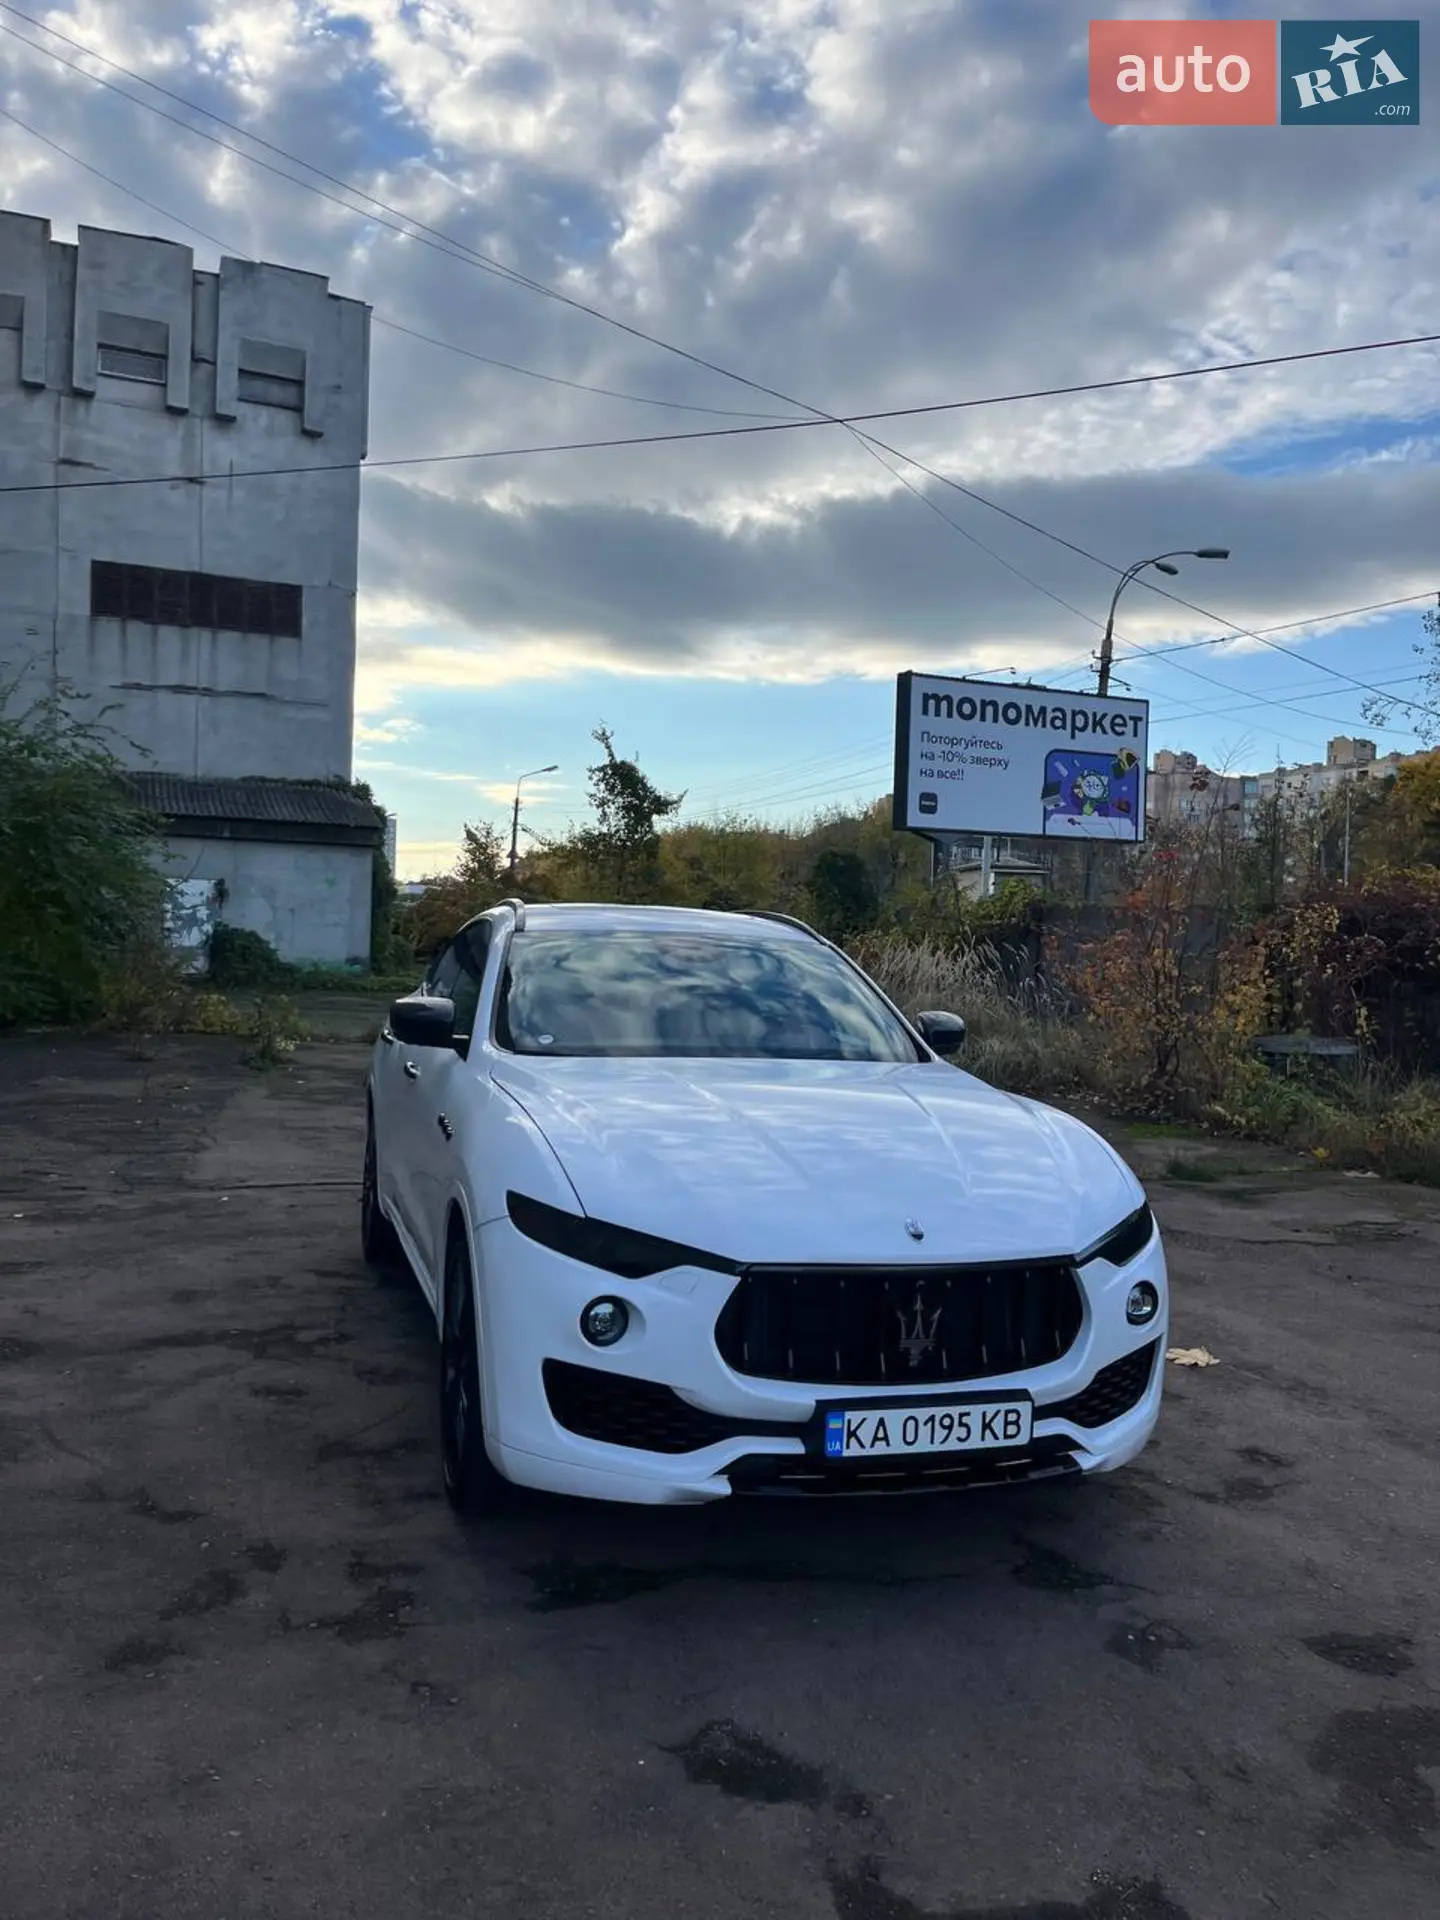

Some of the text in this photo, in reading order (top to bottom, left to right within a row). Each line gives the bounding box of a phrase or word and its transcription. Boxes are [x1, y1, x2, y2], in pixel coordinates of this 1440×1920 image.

[921, 731, 1003, 750] Поторгуйтесь
[920, 750, 1010, 770] на -10% зверху
[920, 768, 964, 780] на все!!
[846, 1408, 1022, 1449] KA 0195 KB
[827, 1441, 841, 1451] UA
